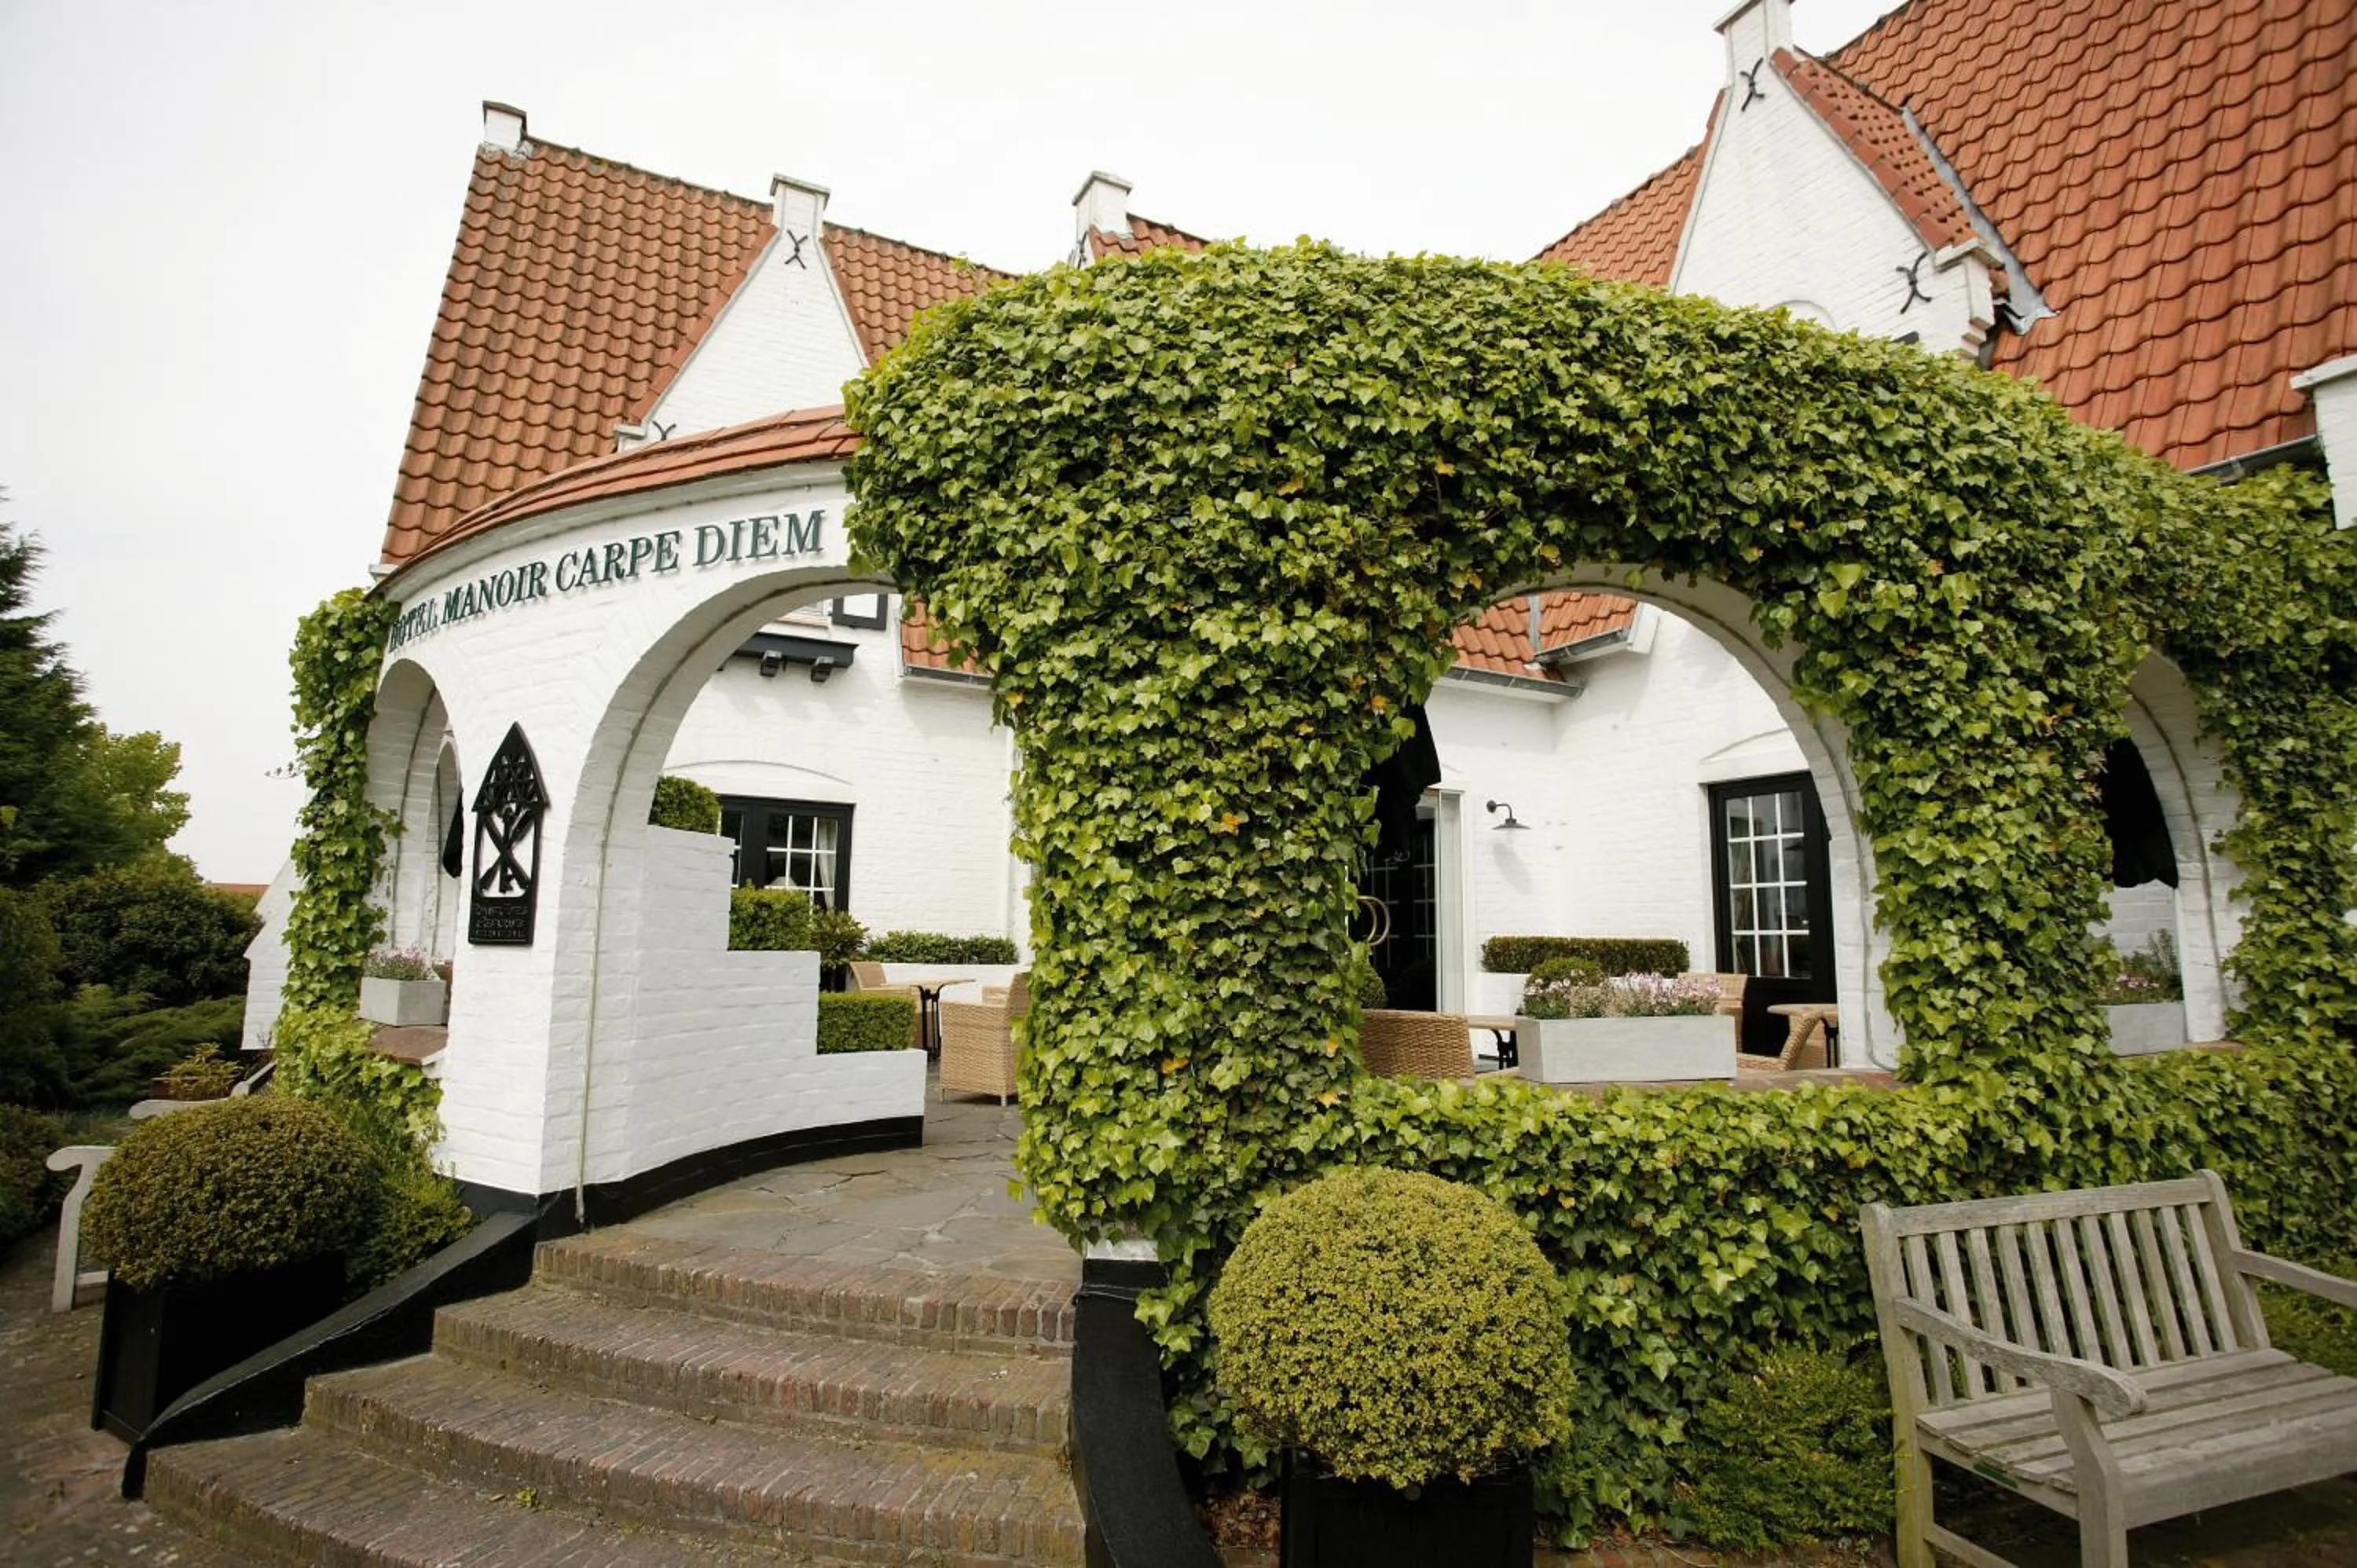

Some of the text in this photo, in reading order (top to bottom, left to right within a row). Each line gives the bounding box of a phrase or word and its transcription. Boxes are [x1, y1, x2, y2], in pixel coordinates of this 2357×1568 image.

[388, 509, 826, 653] HOTEL MANOIR CARPE DIEM
